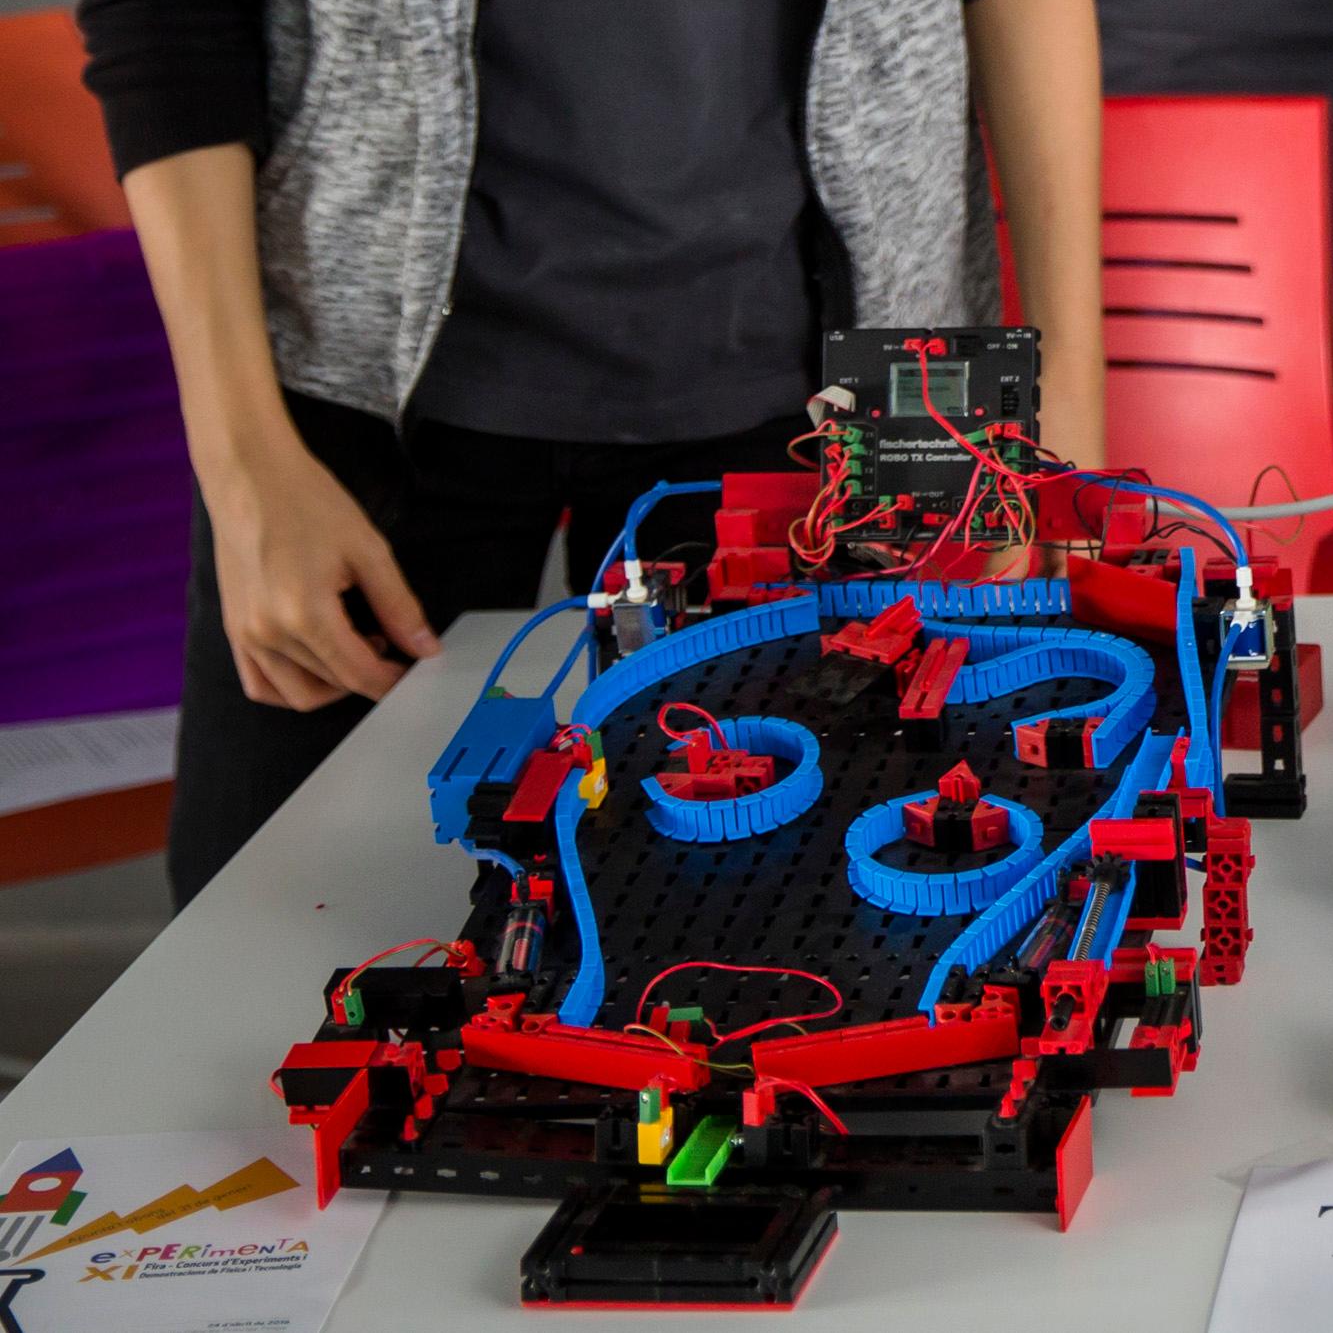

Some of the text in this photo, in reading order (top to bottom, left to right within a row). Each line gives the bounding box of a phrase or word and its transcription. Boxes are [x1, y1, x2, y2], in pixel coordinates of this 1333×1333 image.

[879, 439, 961, 450] fischertechnik
[879, 453, 973, 463] ROBO TX Controller
[143, 1262, 167, 1271] Fira
[175, 1259, 220, 1269] Concurs
[221, 1254, 301, 1266] d'Experiments
[77, 1264, 140, 1283] XI
[139, 1269, 206, 1279] Demostracions
